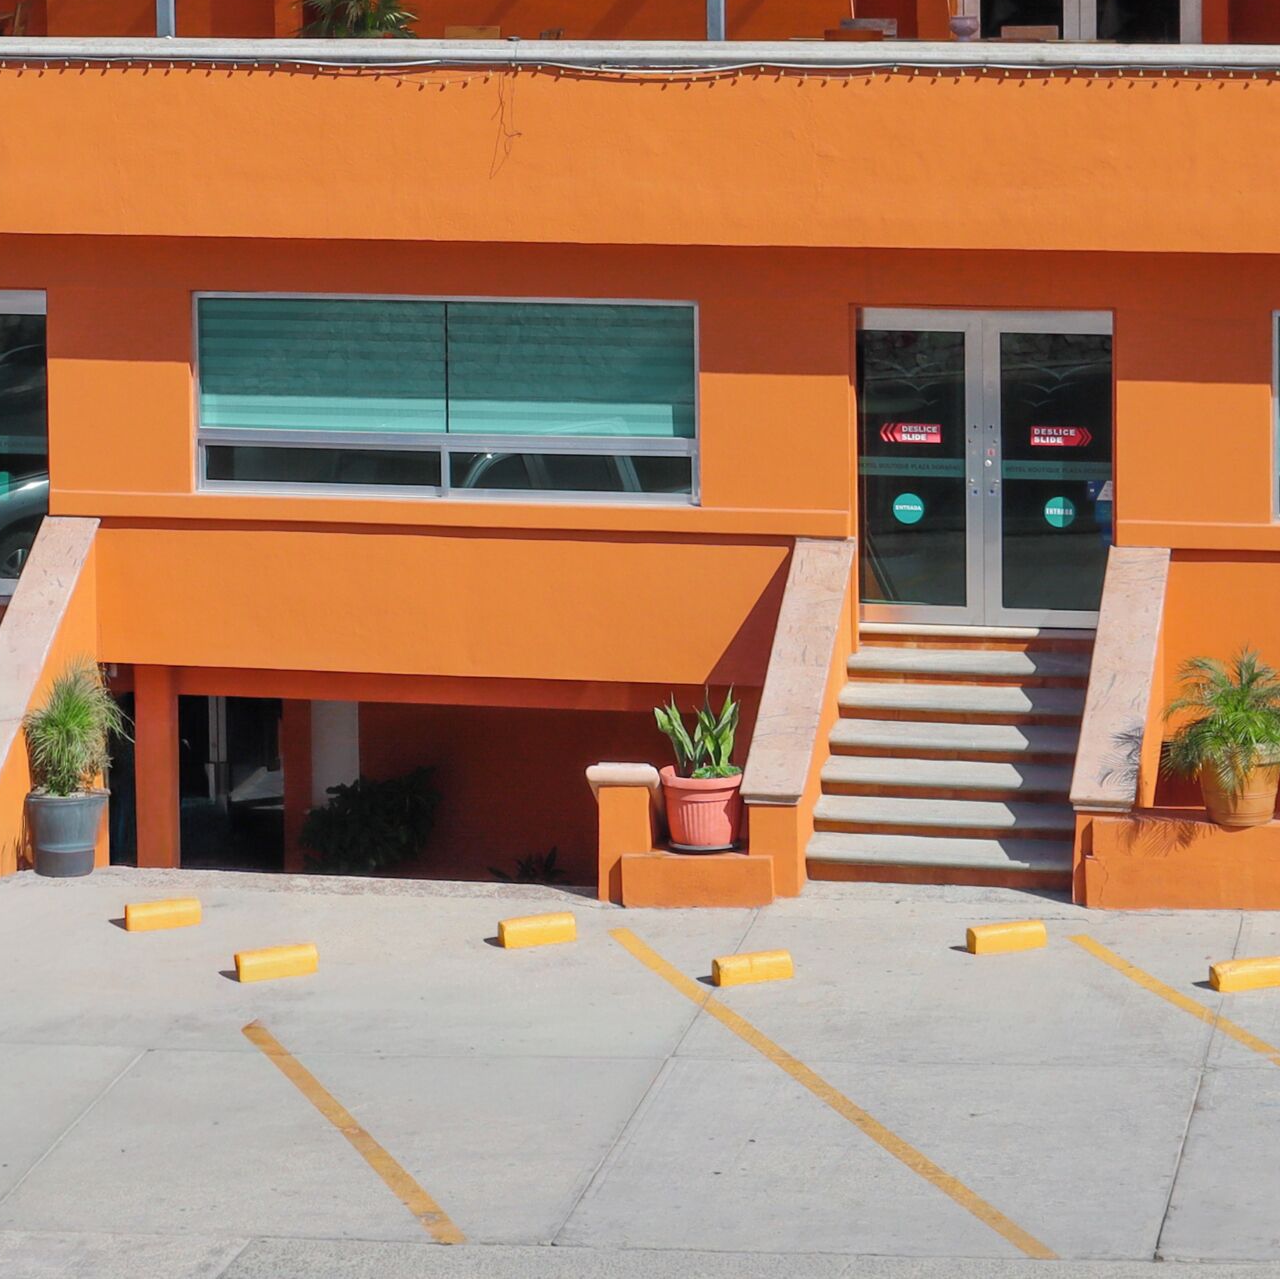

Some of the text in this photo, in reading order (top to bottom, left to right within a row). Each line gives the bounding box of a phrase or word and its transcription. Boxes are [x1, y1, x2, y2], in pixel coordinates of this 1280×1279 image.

[901, 425, 938, 433] DESLICE
[1033, 428, 1076, 436] DESLICE
[901, 433, 927, 441] SLIDE
[1033, 436, 1064, 444] SLIDE
[1046, 507, 1073, 516] ENTRADA
